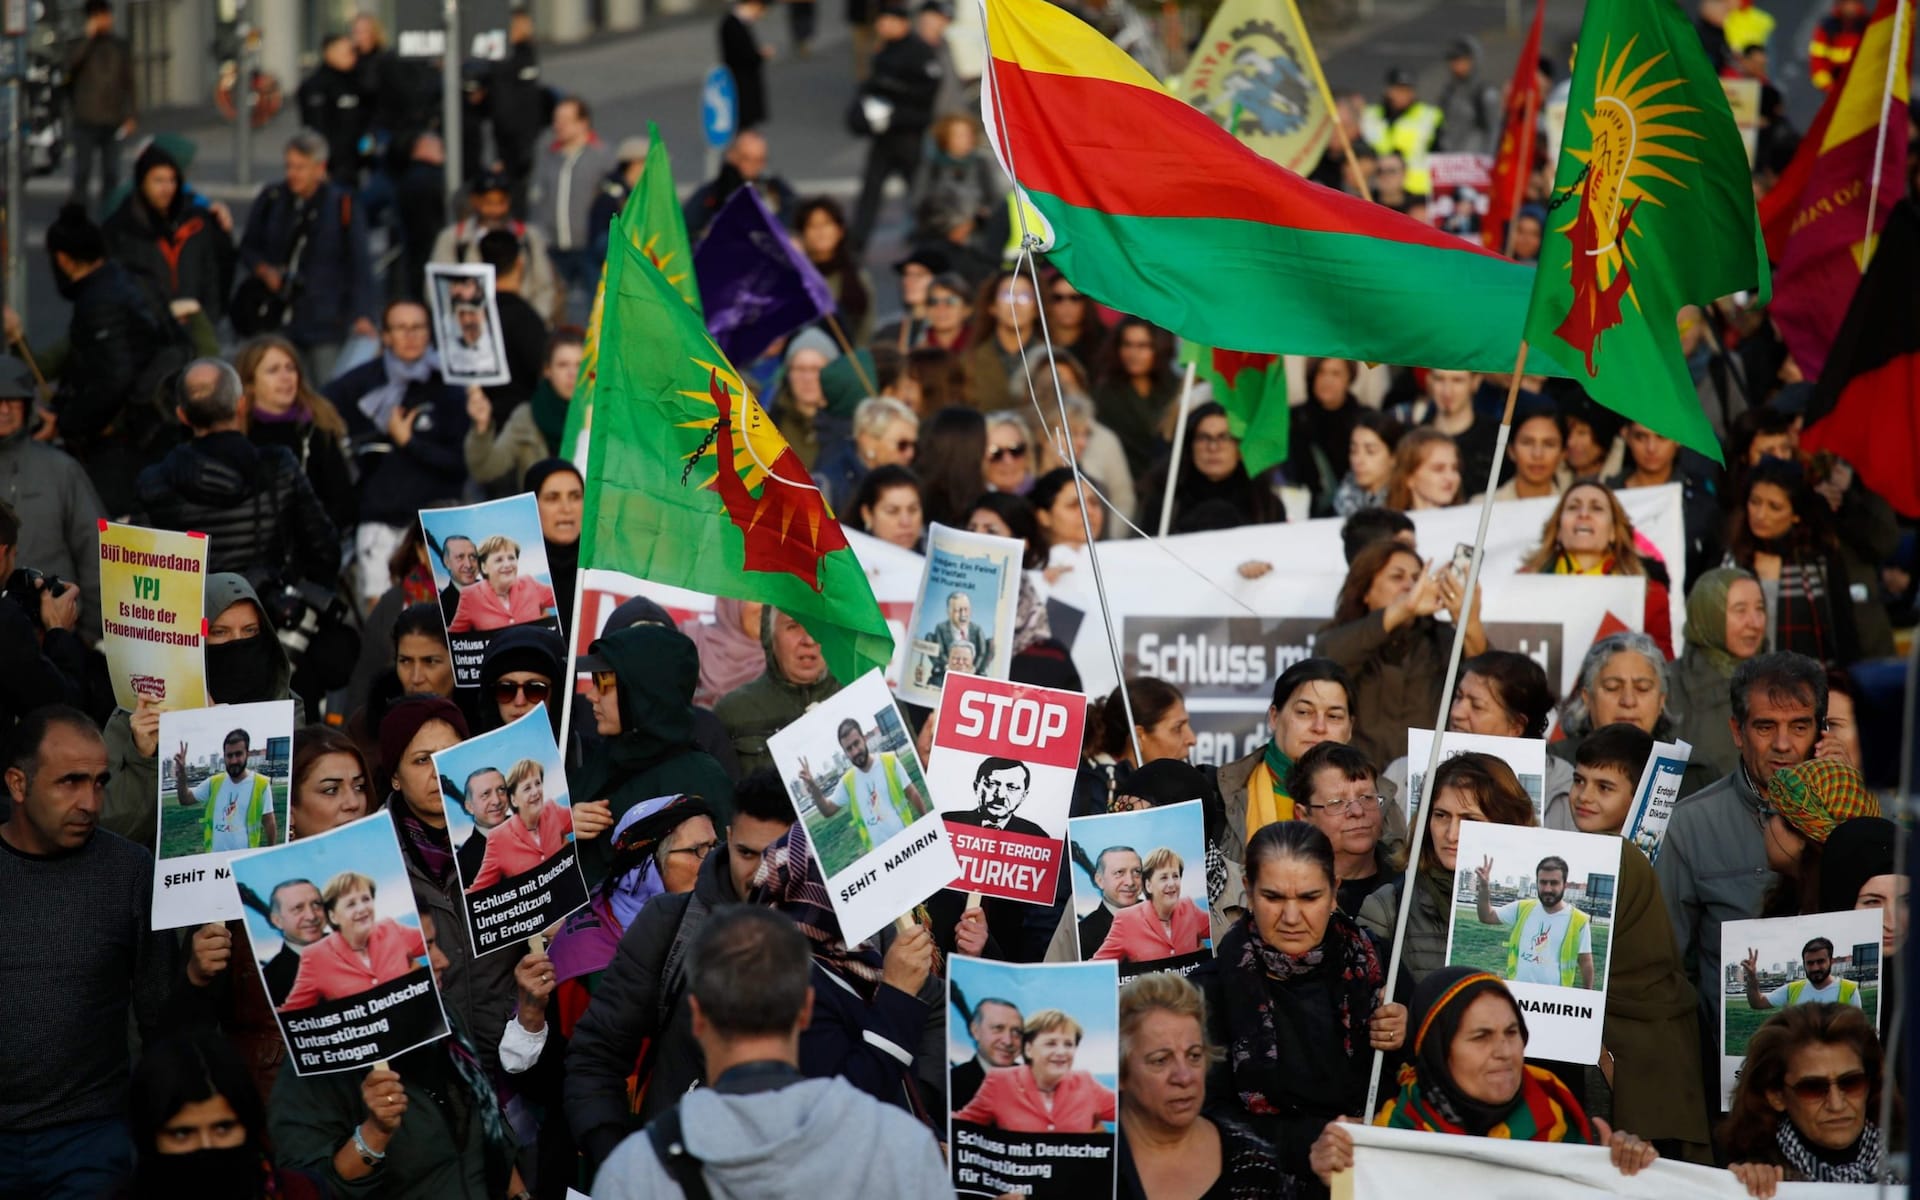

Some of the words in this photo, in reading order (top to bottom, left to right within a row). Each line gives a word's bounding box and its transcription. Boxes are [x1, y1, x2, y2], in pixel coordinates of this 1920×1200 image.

[122, 548, 200, 573] berxwedana
[133, 575, 160, 601] YPJ
[119, 601, 130, 617] Es
[131, 604, 155, 621] lebe
[157, 608, 176, 624] der
[104, 618, 200, 648] Frauenwiderstand
[452, 640, 484, 651] Schluss
[1138, 633, 1267, 684] Schluss
[458, 668, 469, 679] für
[955, 690, 1068, 748] STOP
[884, 829, 939, 873] NAMIRIN
[956, 834, 997, 854] STATE
[1000, 841, 1051, 862] TERROR
[473, 889, 518, 914] Schluss
[519, 879, 538, 897] mit
[537, 854, 575, 888] Deutscher
[957, 855, 1046, 892] TURKEY
[476, 890, 552, 930] Unterstützung
[479, 932, 498, 946] für
[500, 913, 545, 939] Erdogan
[288, 1012, 342, 1033] Schluss
[342, 1004, 368, 1022] mit
[367, 980, 430, 1015] Deutscher
[1518, 999, 1593, 1019] NAMIRIN
[294, 1018, 390, 1050] Unterstützung
[301, 1053, 321, 1067] für
[322, 1042, 379, 1064] Erdogan
[957, 1130, 1006, 1155] Schluss
[1007, 1142, 1033, 1157] mit
[1035, 1142, 1110, 1159] Deutscher
[957, 1149, 1052, 1178] Unterstützung
[958, 1168, 980, 1182] für
